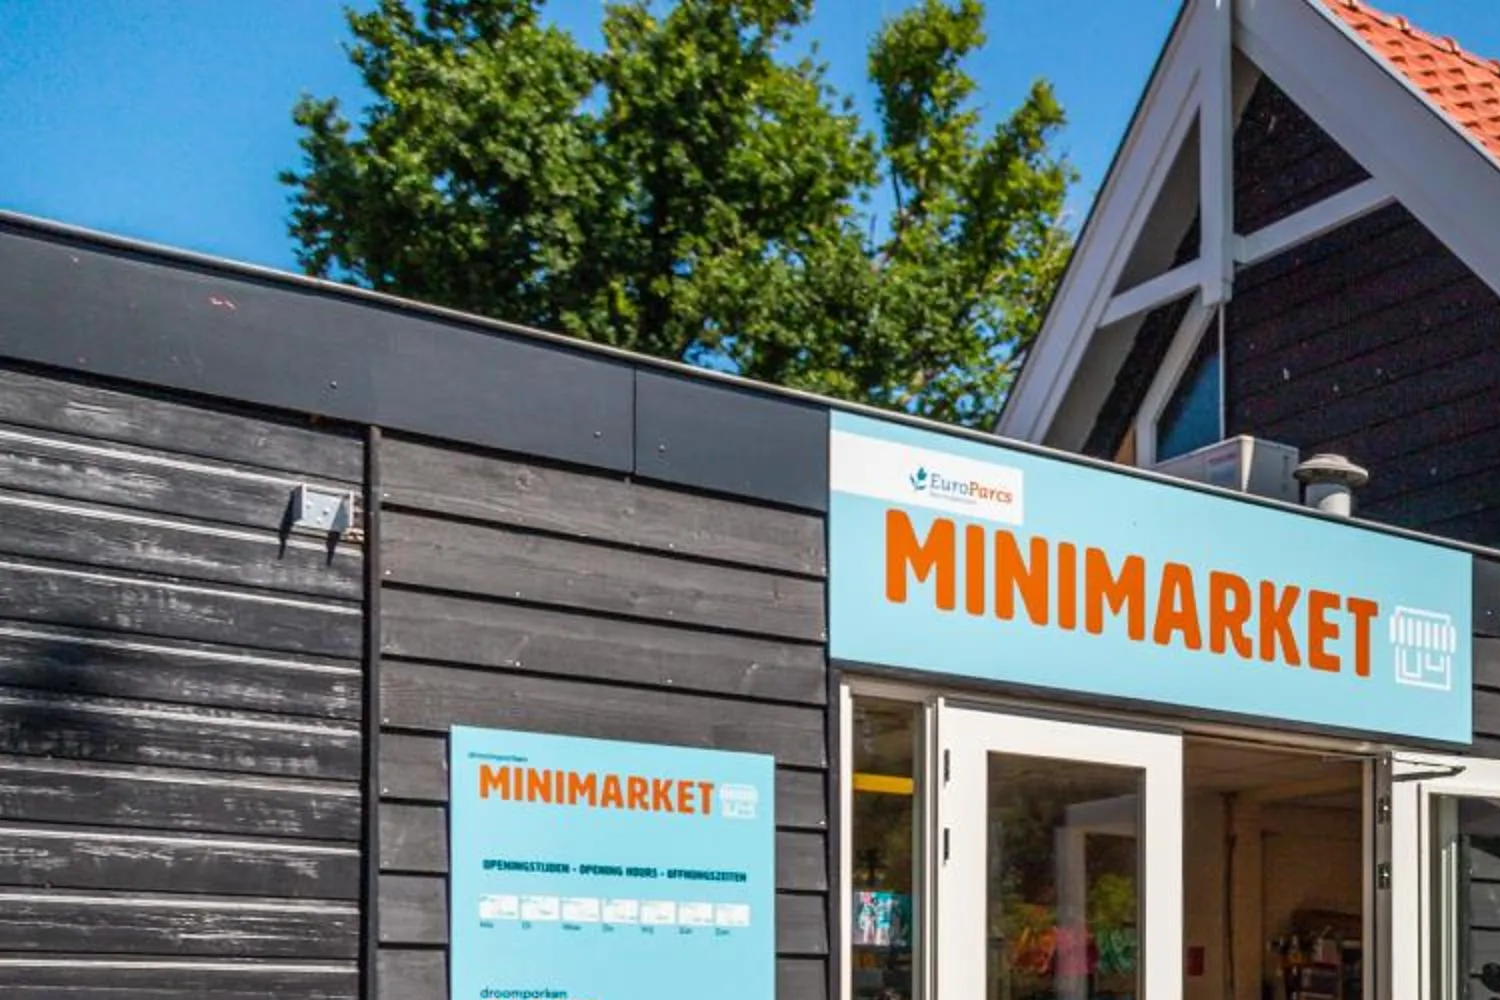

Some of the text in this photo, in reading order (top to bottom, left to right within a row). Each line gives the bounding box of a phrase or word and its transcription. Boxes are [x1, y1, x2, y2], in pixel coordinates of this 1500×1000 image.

[930, 473, 1013, 503] EuroParcs
[885, 508, 1379, 678] MINIMARKET
[479, 764, 715, 815] MINIMARKET
